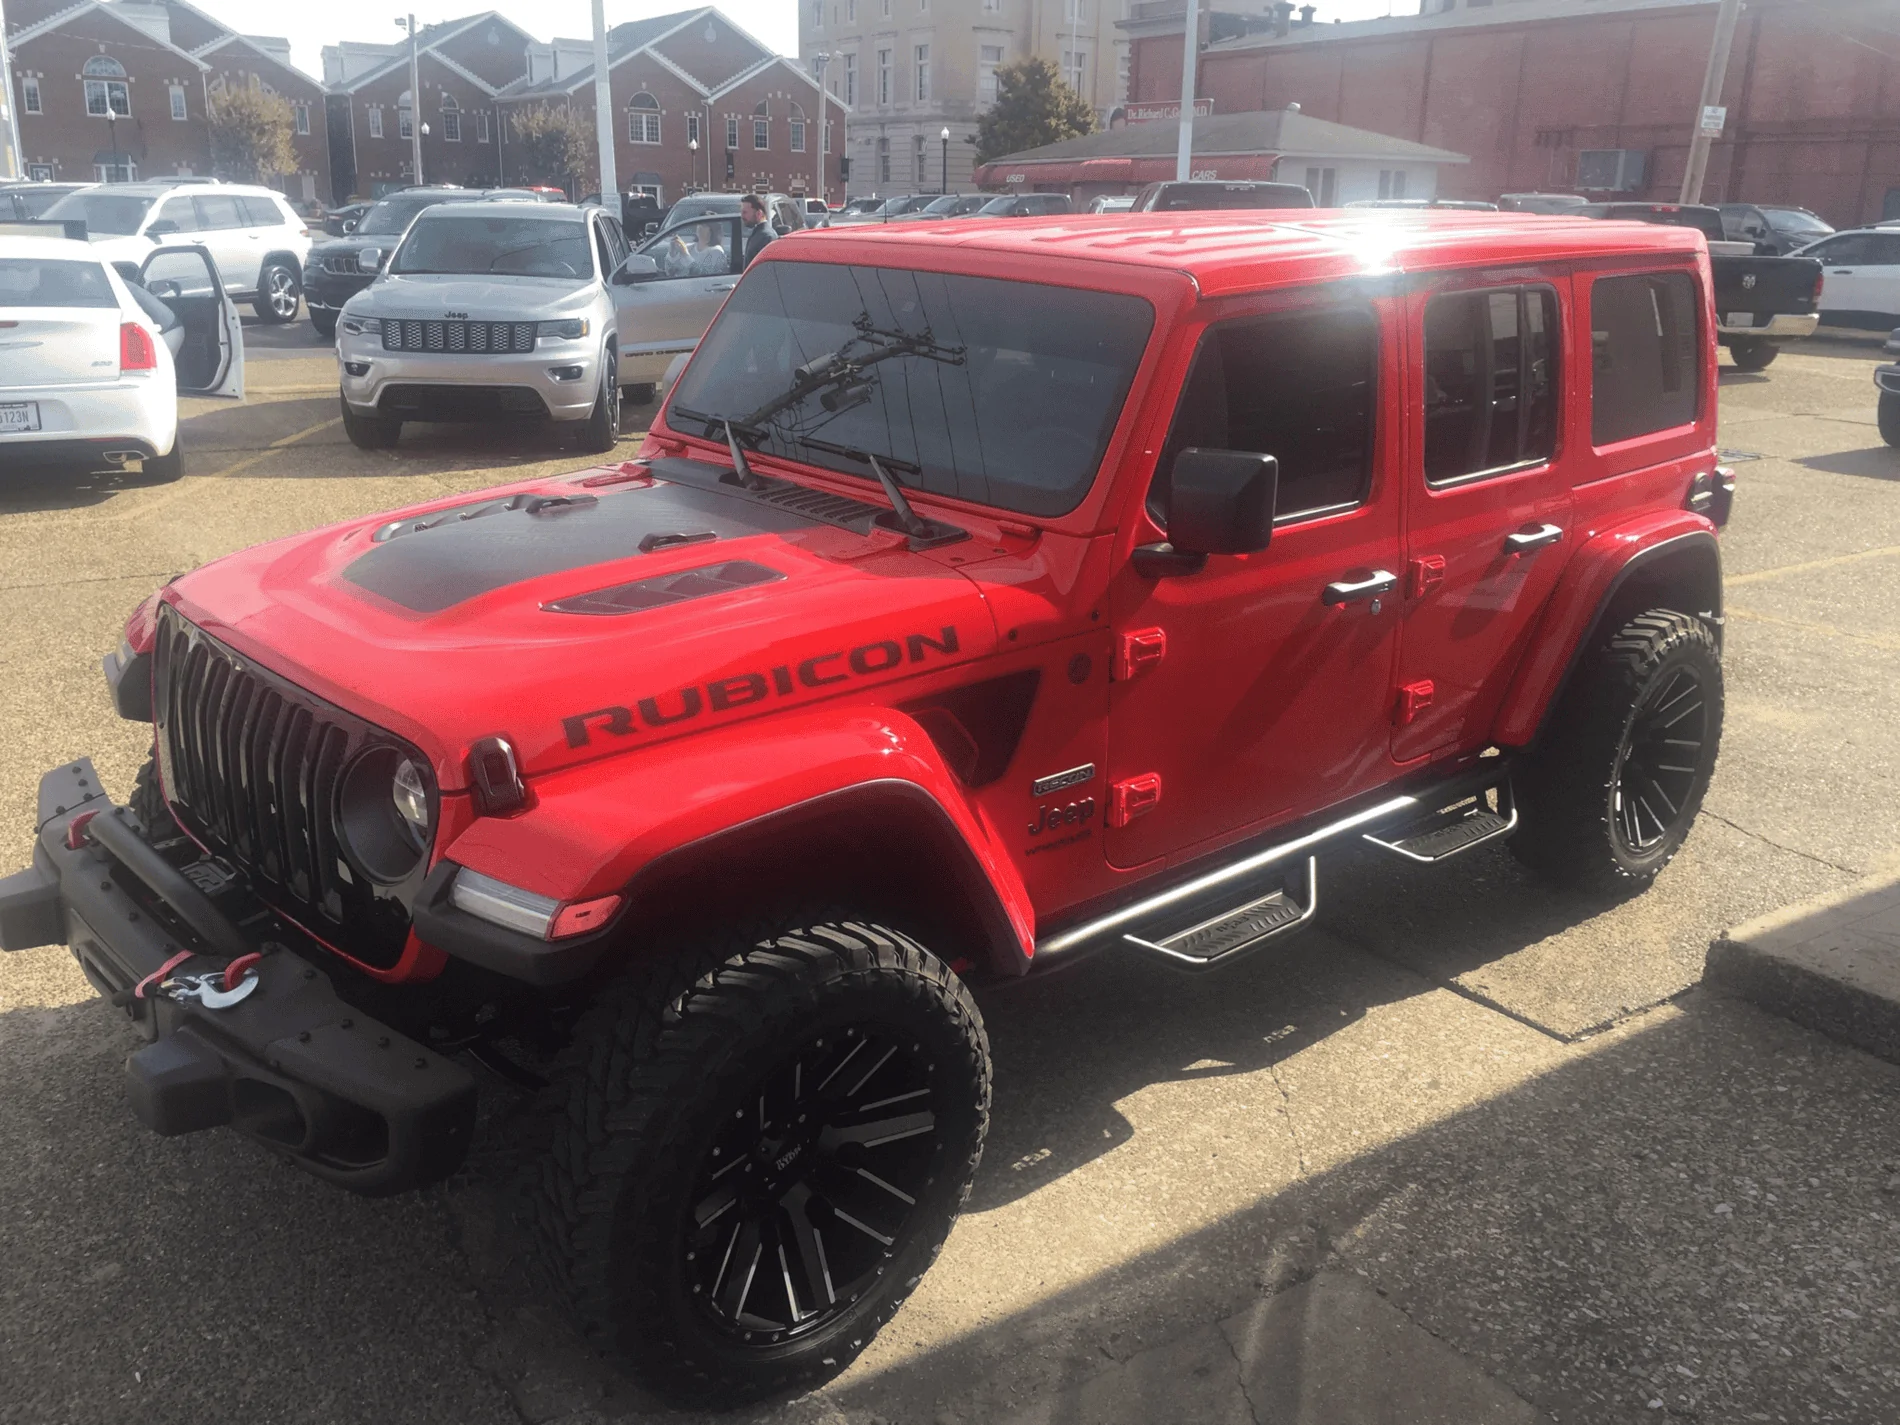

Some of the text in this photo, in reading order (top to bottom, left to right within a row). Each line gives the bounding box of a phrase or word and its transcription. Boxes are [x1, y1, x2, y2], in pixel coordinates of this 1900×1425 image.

[1006, 170, 1217, 183] USED CARS
[445, 310, 469, 320] Jeep
[561, 626, 961, 749] RUBICON
[1028, 797, 1095, 836] Jeep
